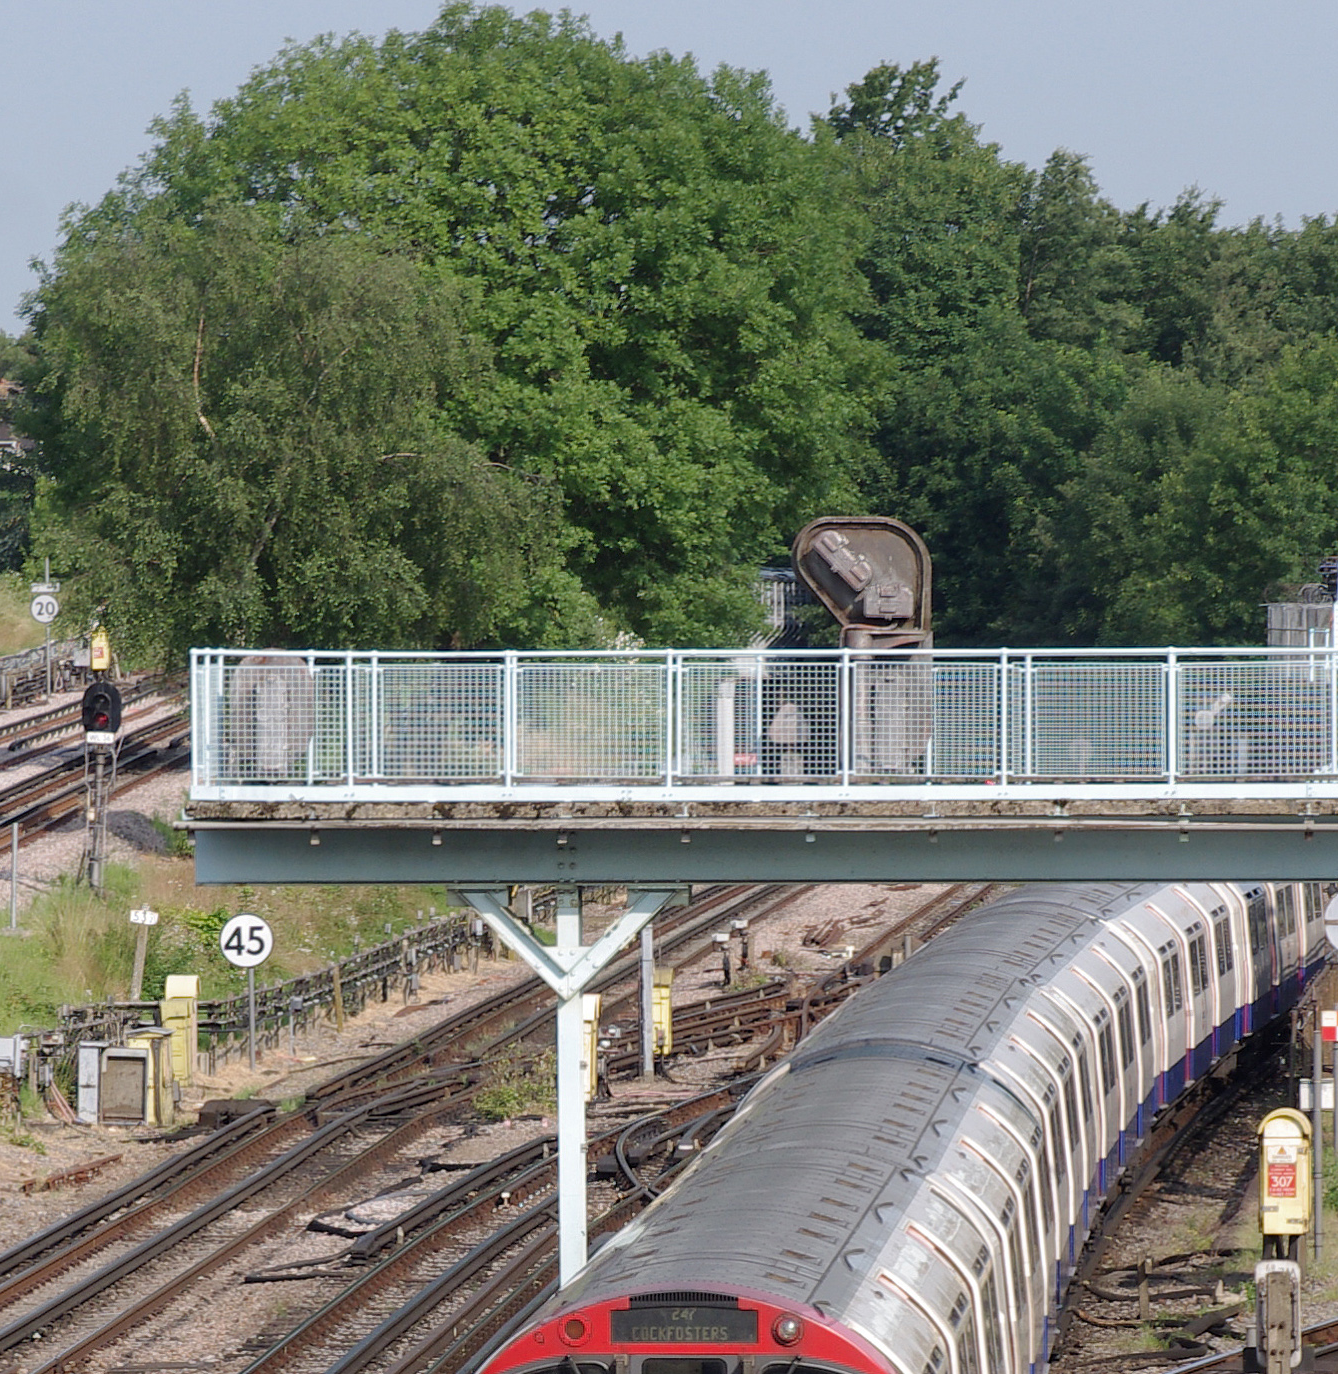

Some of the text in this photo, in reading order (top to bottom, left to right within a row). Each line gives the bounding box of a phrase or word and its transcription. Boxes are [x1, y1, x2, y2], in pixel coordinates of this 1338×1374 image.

[35, 601, 55, 616] 20
[224, 926, 265, 955] 45
[1270, 1175, 1294, 1188] 307
[671, 1308, 697, 1321] 247
[631, 1326, 729, 1341] COCKFOSTERS
